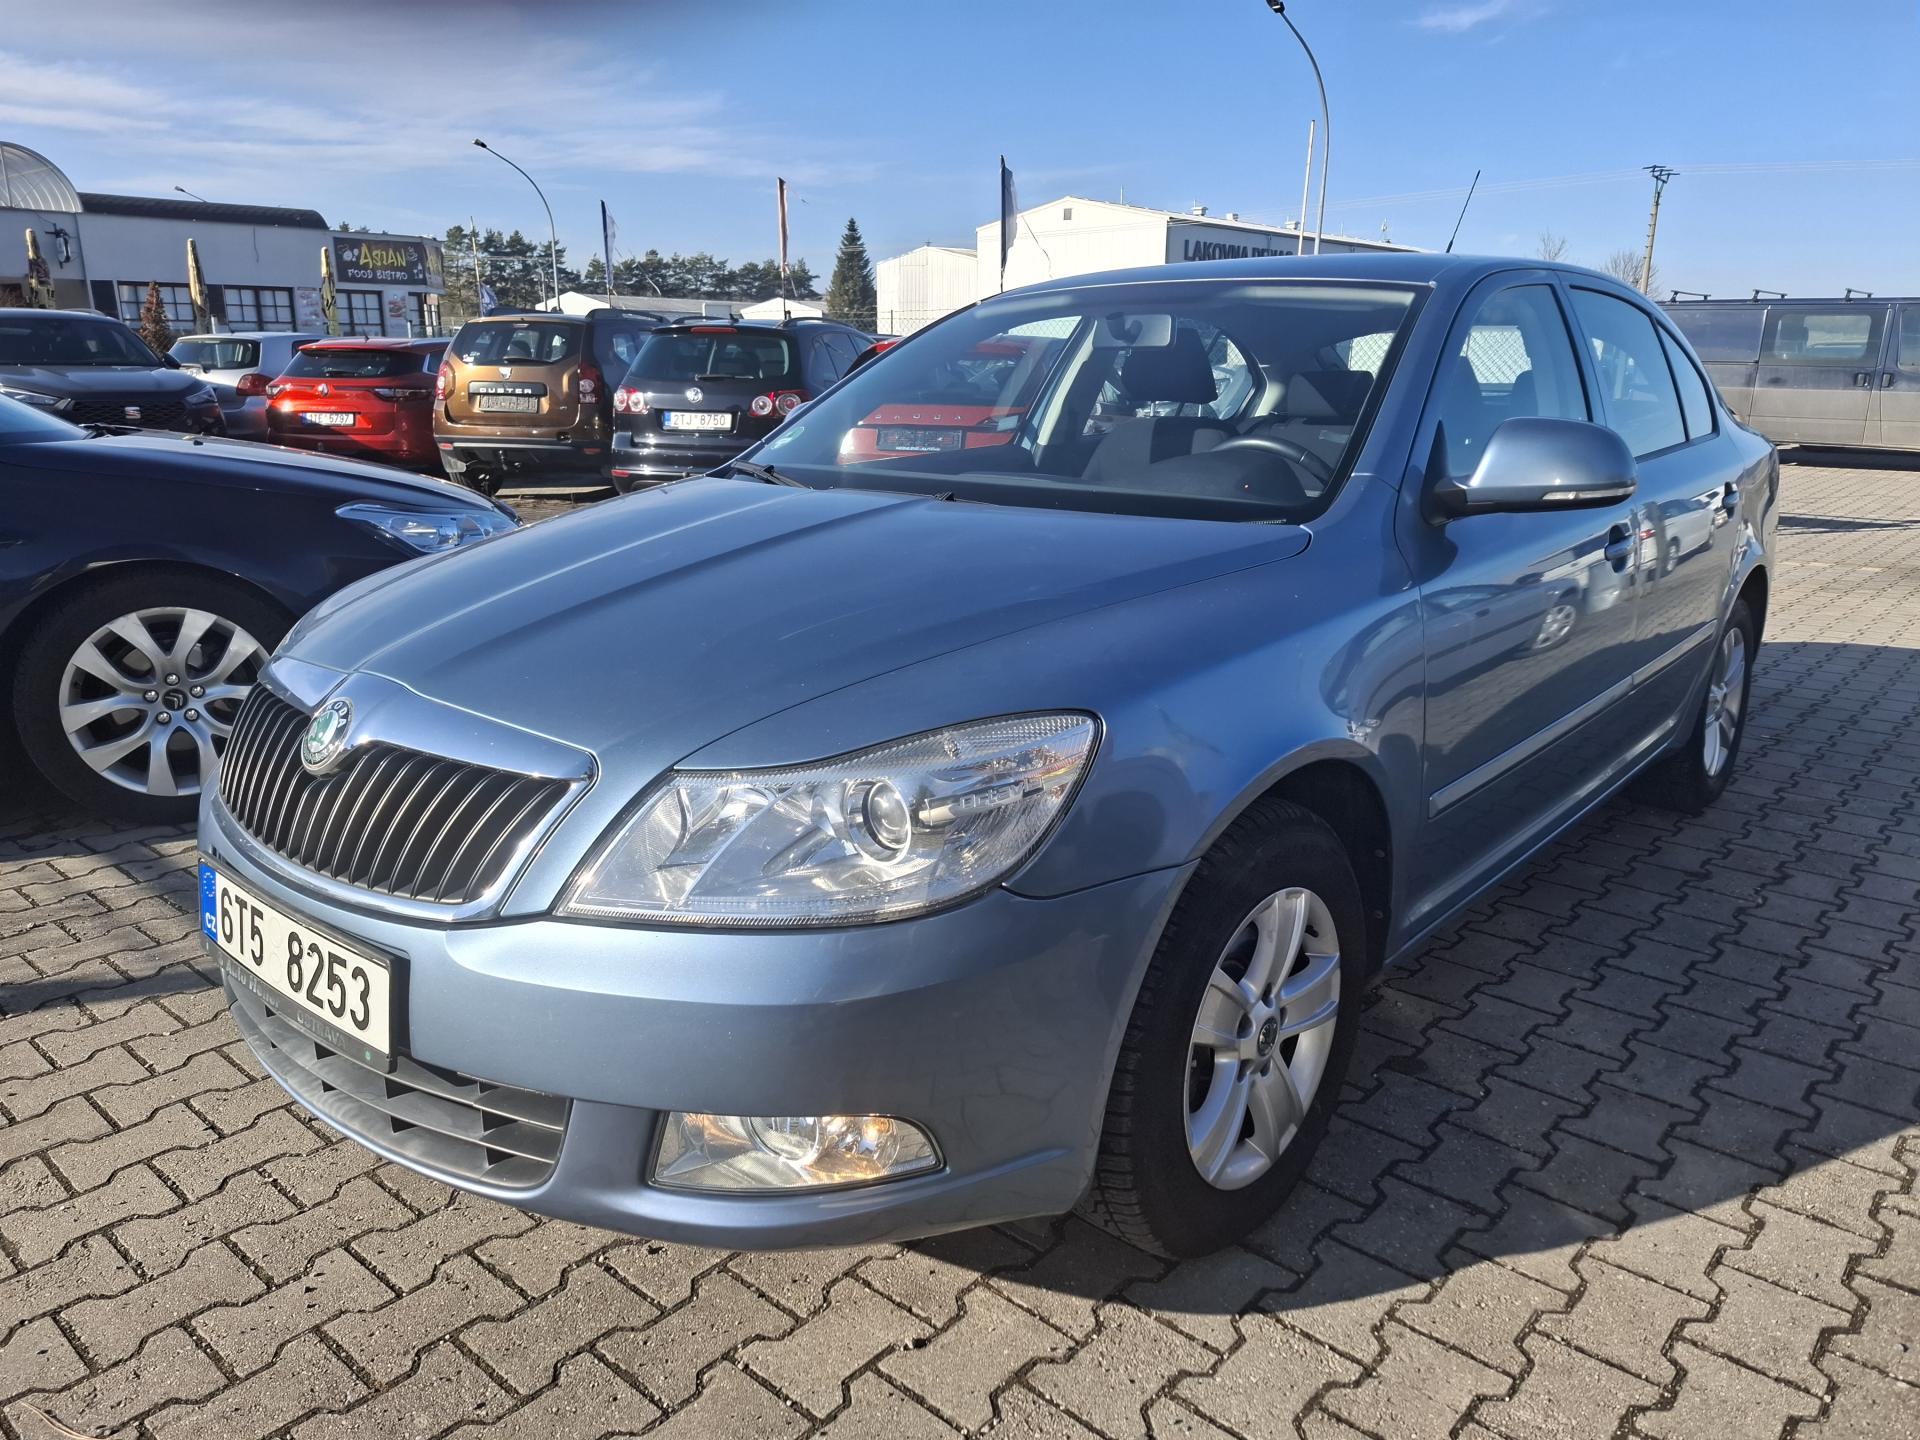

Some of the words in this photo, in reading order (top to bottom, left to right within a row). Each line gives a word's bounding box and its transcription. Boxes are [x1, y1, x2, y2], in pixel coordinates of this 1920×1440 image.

[359, 243, 407, 268] ASIAN
[1184, 240, 1249, 262] LAKOVNA
[347, 269, 373, 279] FOOD
[376, 270, 408, 280] BISTRO
[673, 414, 692, 426] 2TJ
[700, 414, 726, 426] 8750
[205, 912, 217, 932] CZ
[221, 887, 264, 967] 6T5
[287, 931, 371, 1031] 8253
